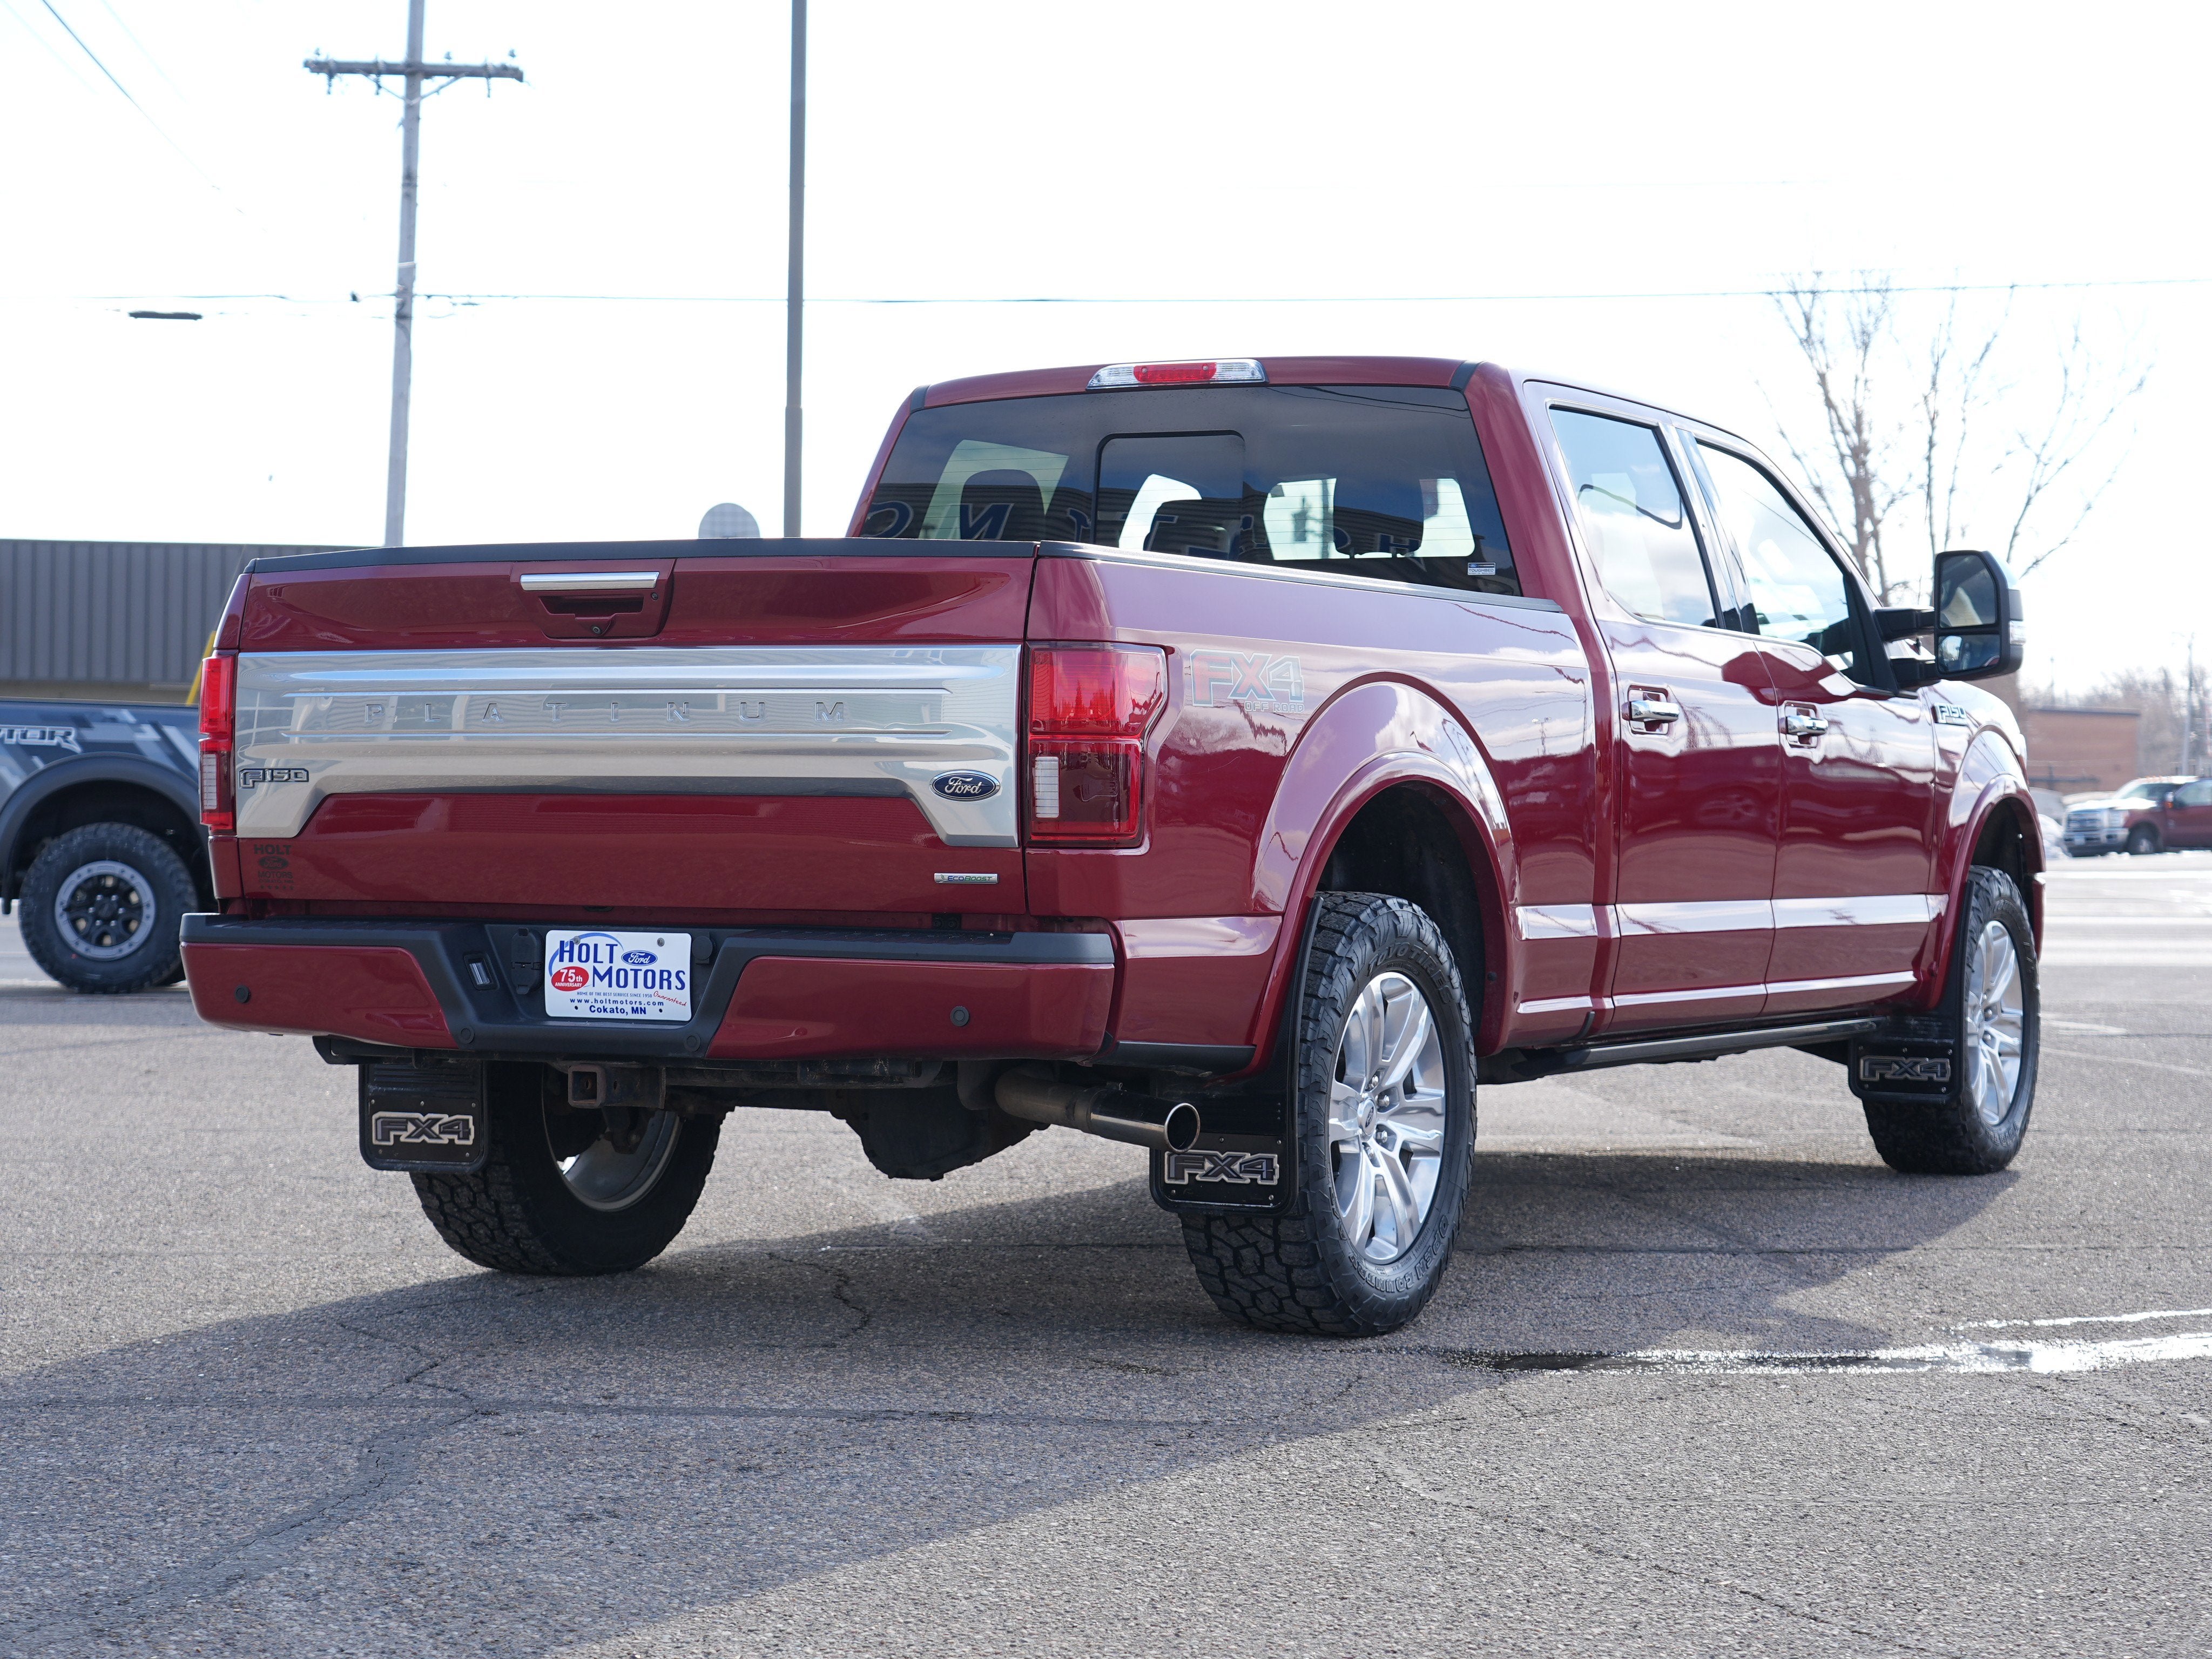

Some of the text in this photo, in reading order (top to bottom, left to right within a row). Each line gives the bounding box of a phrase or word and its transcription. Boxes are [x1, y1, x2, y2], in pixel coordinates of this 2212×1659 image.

[1190, 648, 1305, 707] FX4
[365, 702, 844, 723] PLATINUM
[1245, 701, 1305, 713] OFF ROAD
[0, 725, 82, 754] TOR
[239, 768, 309, 788] F150
[945, 777, 982, 794] Ford
[254, 844, 292, 855] HOLT
[258, 871, 294, 879] MOTORS
[559, 940, 618, 964] HOLT
[628, 951, 650, 964] Ford
[560, 969, 583, 983] 75th
[592, 965, 686, 990] MOTORS
[570, 998, 664, 1007] www.holtmotors.com
[653, 990, 687, 1007] Guaranteed
[589, 1005, 646, 1016] Cokato, MN
[1860, 1055, 1951, 1082] FX4
[372, 1111, 474, 1146] FX4
[1165, 1149, 1279, 1185] FX4
